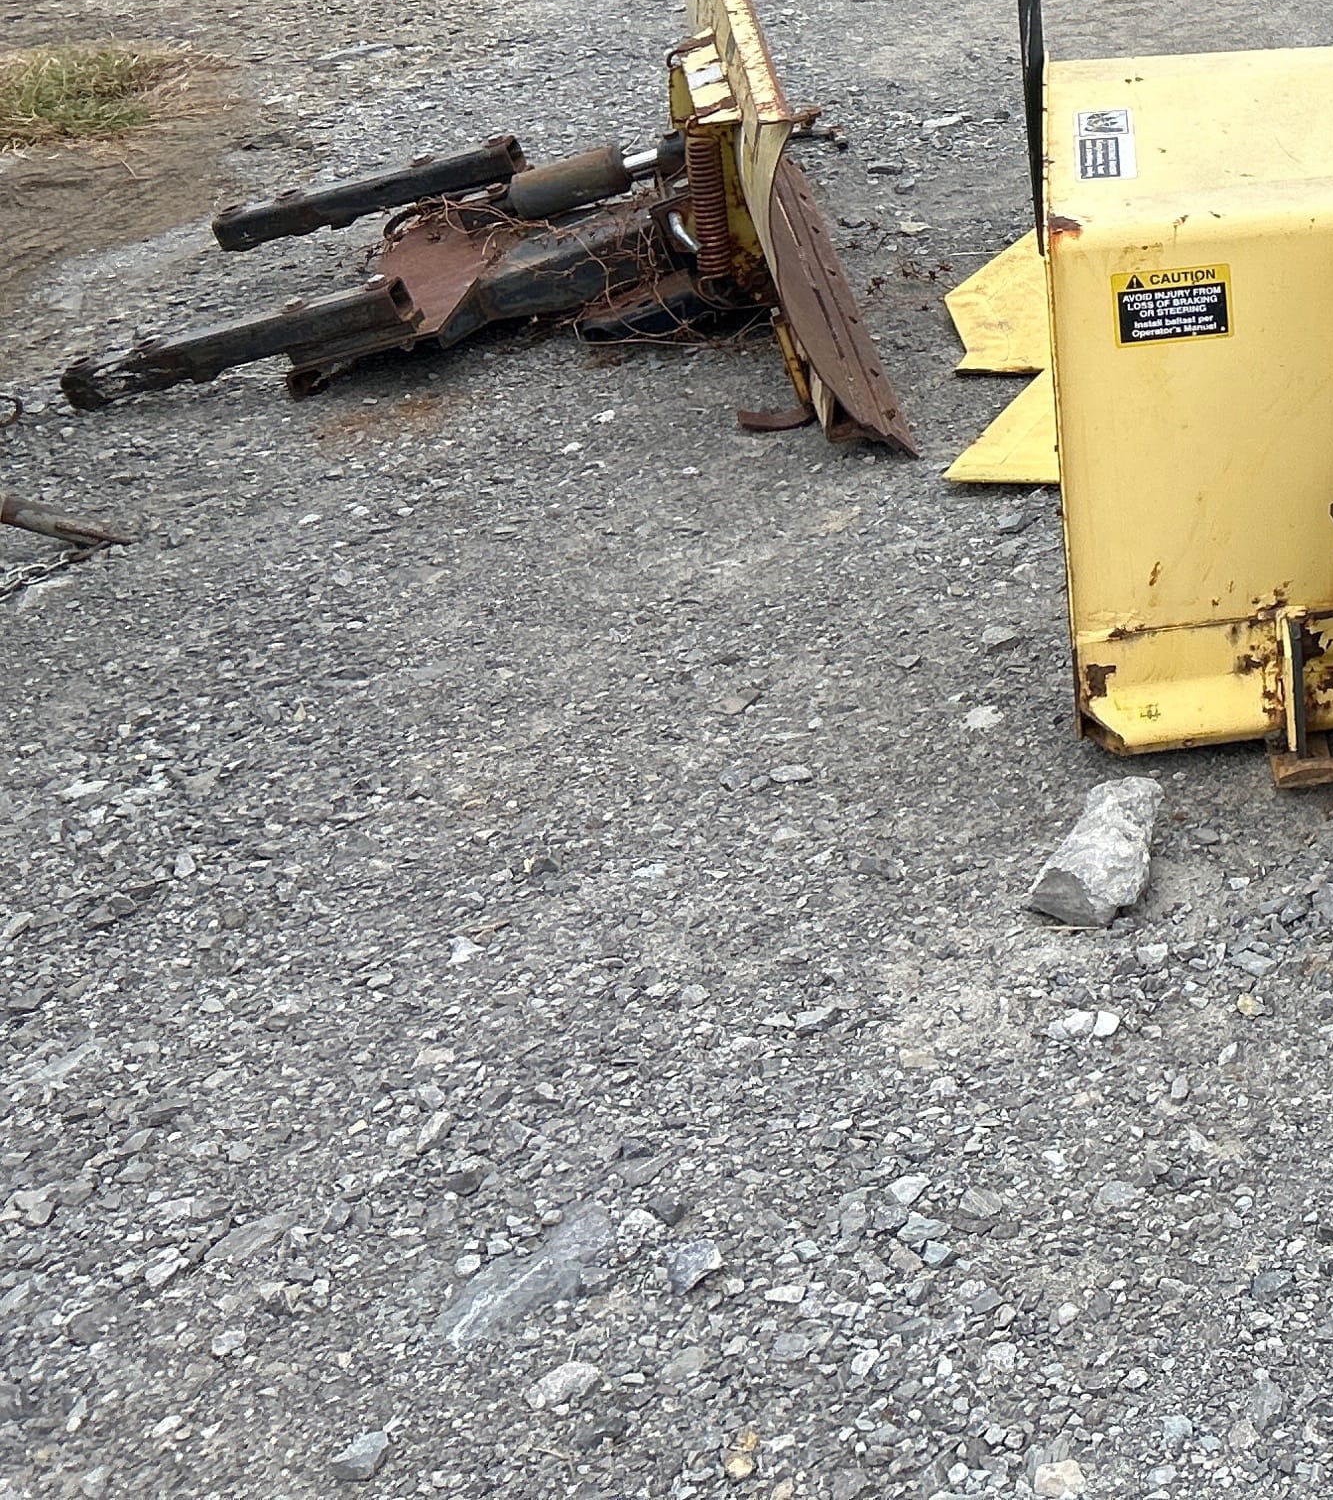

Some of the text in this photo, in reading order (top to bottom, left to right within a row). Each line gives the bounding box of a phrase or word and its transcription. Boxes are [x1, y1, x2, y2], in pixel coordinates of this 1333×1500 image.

[1149, 268, 1216, 285] CAUTION
[1122, 285, 1221, 303] AVOID INJURY FROM
[1127, 295, 1218, 311] LOSS OF BRAKING
[1139, 304, 1207, 318] OR STEERING
[1132, 321, 1217, 339] Operator's Manual
[1134, 315, 1214, 329] Install ballast per
